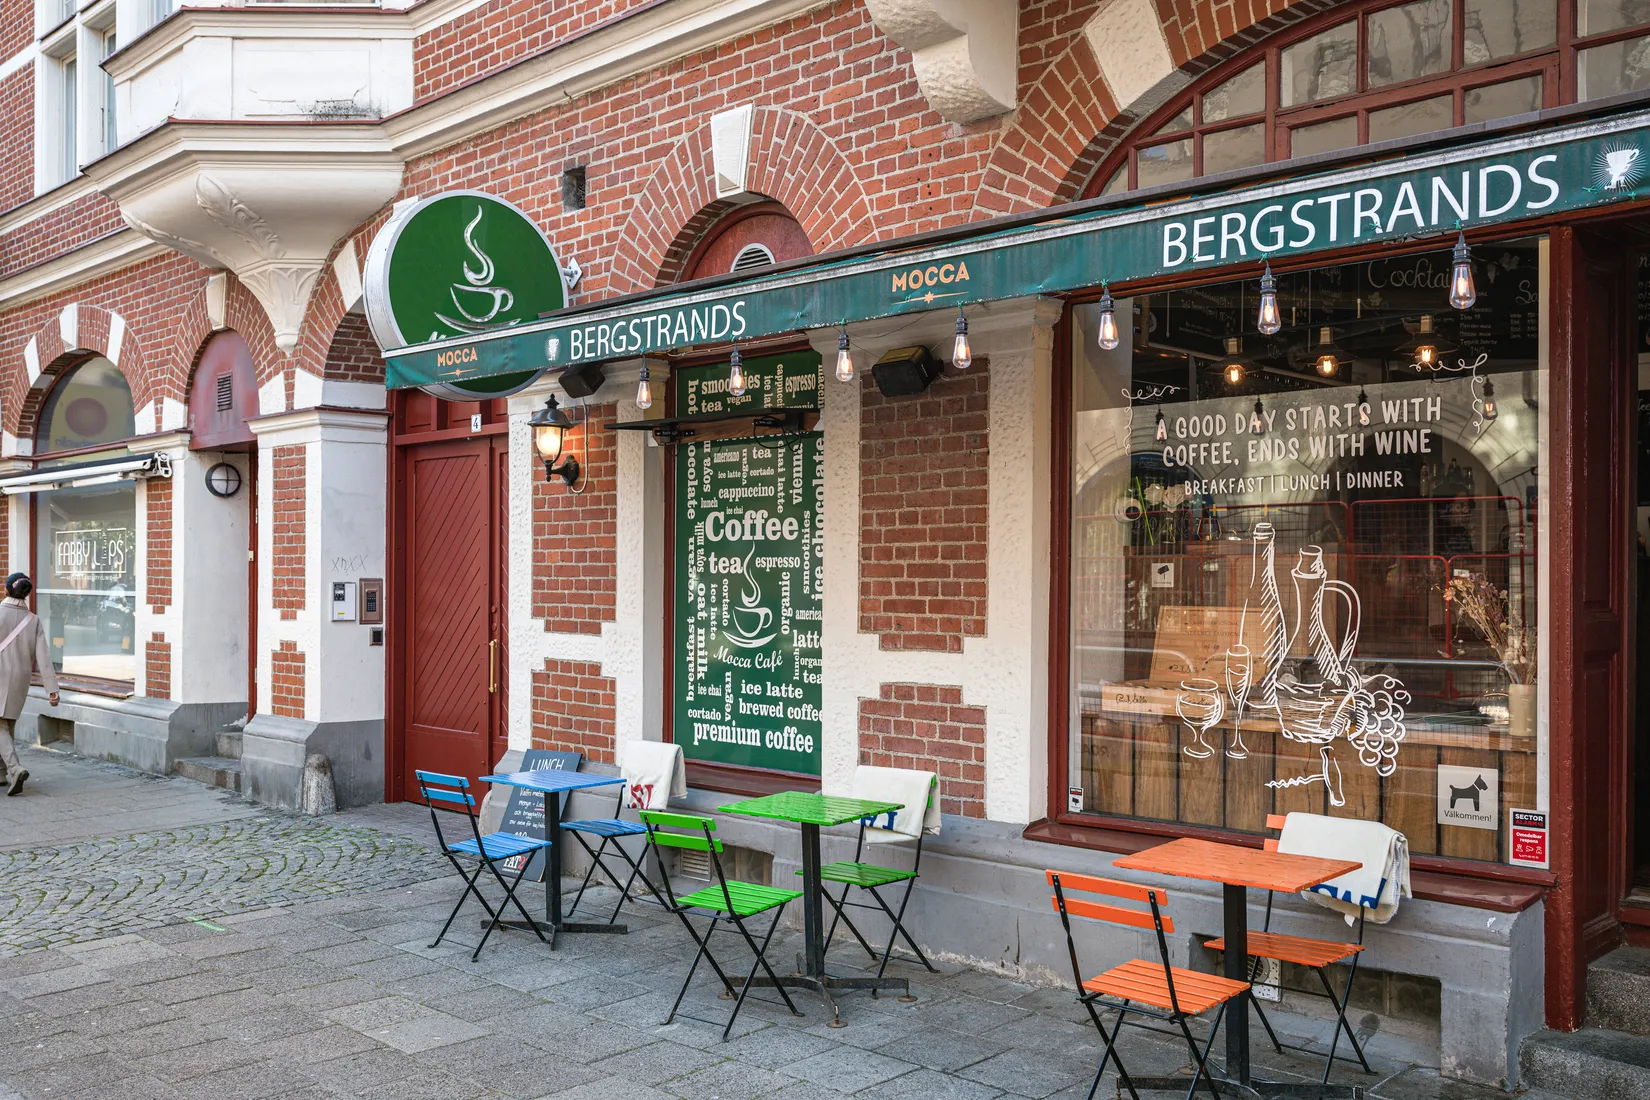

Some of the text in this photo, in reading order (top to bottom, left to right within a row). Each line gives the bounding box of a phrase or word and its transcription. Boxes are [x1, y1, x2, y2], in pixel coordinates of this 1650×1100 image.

[1162, 154, 1560, 269] BERGSTRANDS
[891, 261, 970, 293] MOCCA
[1367, 257, 1452, 290] Cocktai
[570, 301, 746, 361] BERGSTRANDS
[437, 346, 478, 367] MOCCA
[701, 371, 761, 396] smooies
[763, 375, 773, 391] ice
[775, 363, 784, 409] cappucci
[785, 373, 817, 399] espresso
[687, 379, 699, 415] hot
[701, 400, 722, 414] tea
[726, 394, 752, 406] vegan
[763, 393, 773, 409] lat
[473, 417, 479, 430] 4
[1156, 396, 1441, 440] A GOOD DAY STARTS WITH
[713, 449, 740, 464] americano
[752, 446, 772, 459] tea
[1162, 428, 1432, 468] COFFEE, ENDS WITH WINE
[703, 456, 713, 493] soya
[717, 468, 741, 479] ice latte
[742, 447, 750, 486] vegan
[749, 466, 775, 477] cortado
[777, 440, 786, 514] chai latte
[789, 443, 803, 505] vienna
[687, 441, 699, 520] ocolate
[718, 482, 775, 502] cappuccino
[1184, 470, 1404, 496] BREAKFAST LUNCH DINNER
[700, 496, 719, 509] lunch
[733, 506, 744, 515] chai
[705, 509, 799, 542] Coffee
[811, 437, 824, 601] ice chocolate
[694, 521, 706, 573] soya milk
[802, 510, 811, 595] smoothies
[687, 535, 699, 604] vegan
[708, 552, 743, 574] tea
[755, 556, 801, 573] espresso
[722, 578, 731, 627] cortado
[778, 571, 793, 635] organic
[795, 607, 822, 621] america
[696, 583, 708, 680] oat milk
[710, 607, 718, 640] latte
[686, 616, 696, 702] breakfast
[713, 645, 784, 673] Mocca Café
[697, 683, 722, 696] ice chai
[741, 679, 803, 699] ice latte
[802, 669, 822, 685] tea
[724, 671, 734, 722] vegan
[738, 698, 784, 718] brewed
[687, 707, 721, 721] cortado
[693, 720, 814, 754] premium coffee
[530, 758, 565, 773] LUNCH
[1443, 809, 1492, 823] Välkommen!
[1515, 813, 1544, 822] SECTOR
